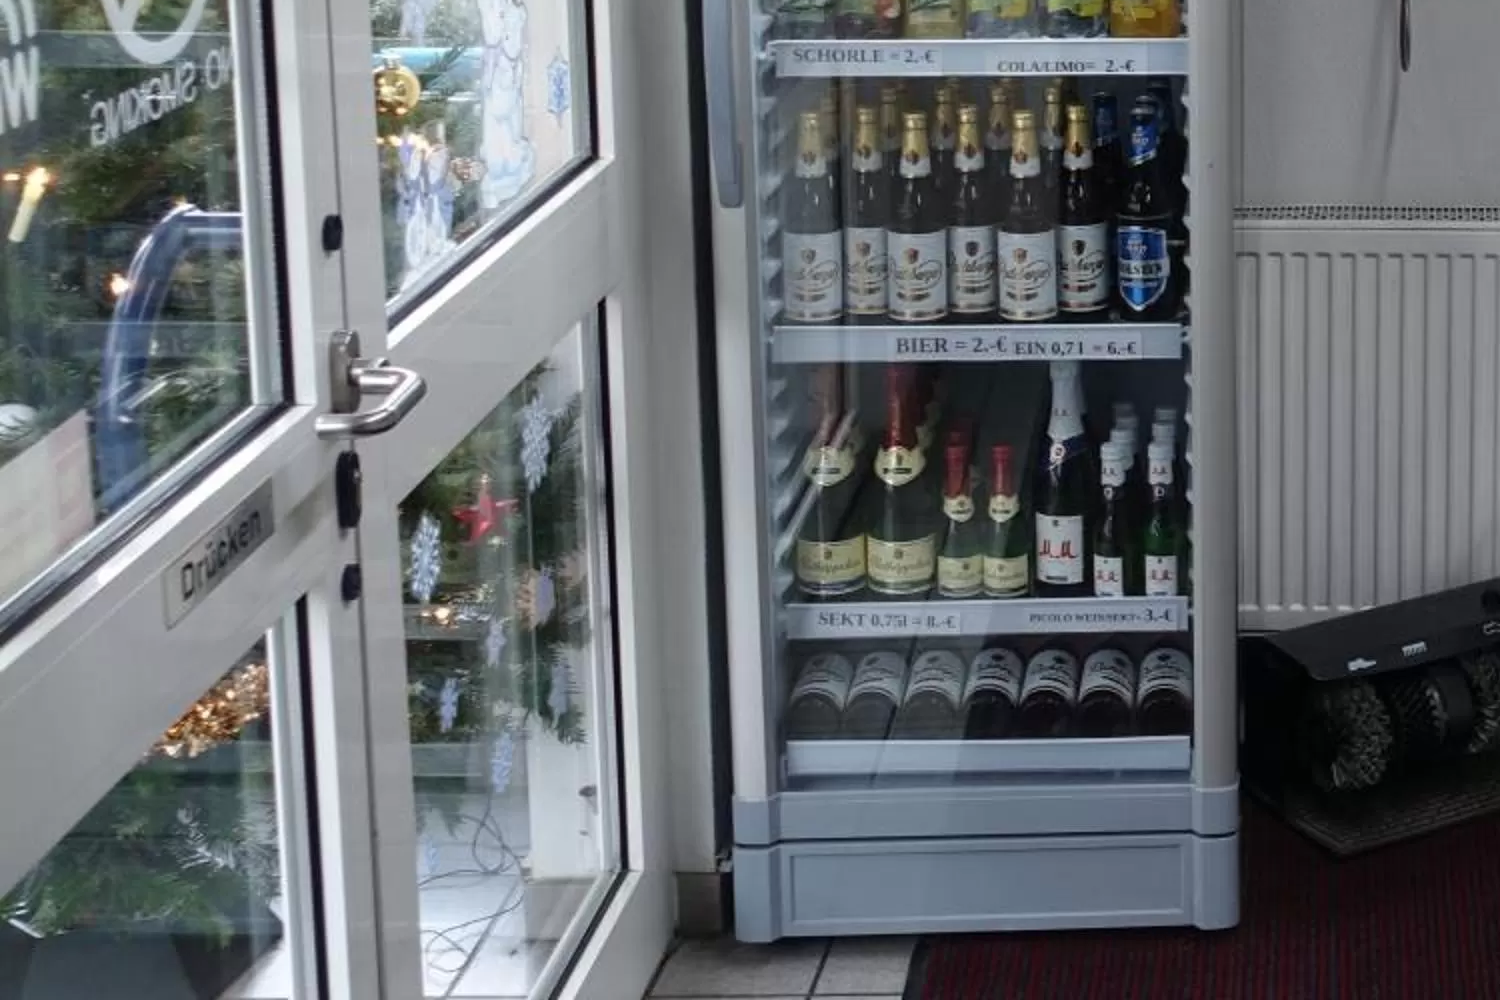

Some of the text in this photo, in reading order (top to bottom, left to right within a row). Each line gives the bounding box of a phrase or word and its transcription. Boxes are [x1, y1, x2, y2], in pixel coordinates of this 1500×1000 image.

[793, 48, 885, 63] SCHORLE
[896, 336, 949, 353] BIER
[181, 509, 262, 602] Drücken
[818, 612, 866, 628] SEKT
